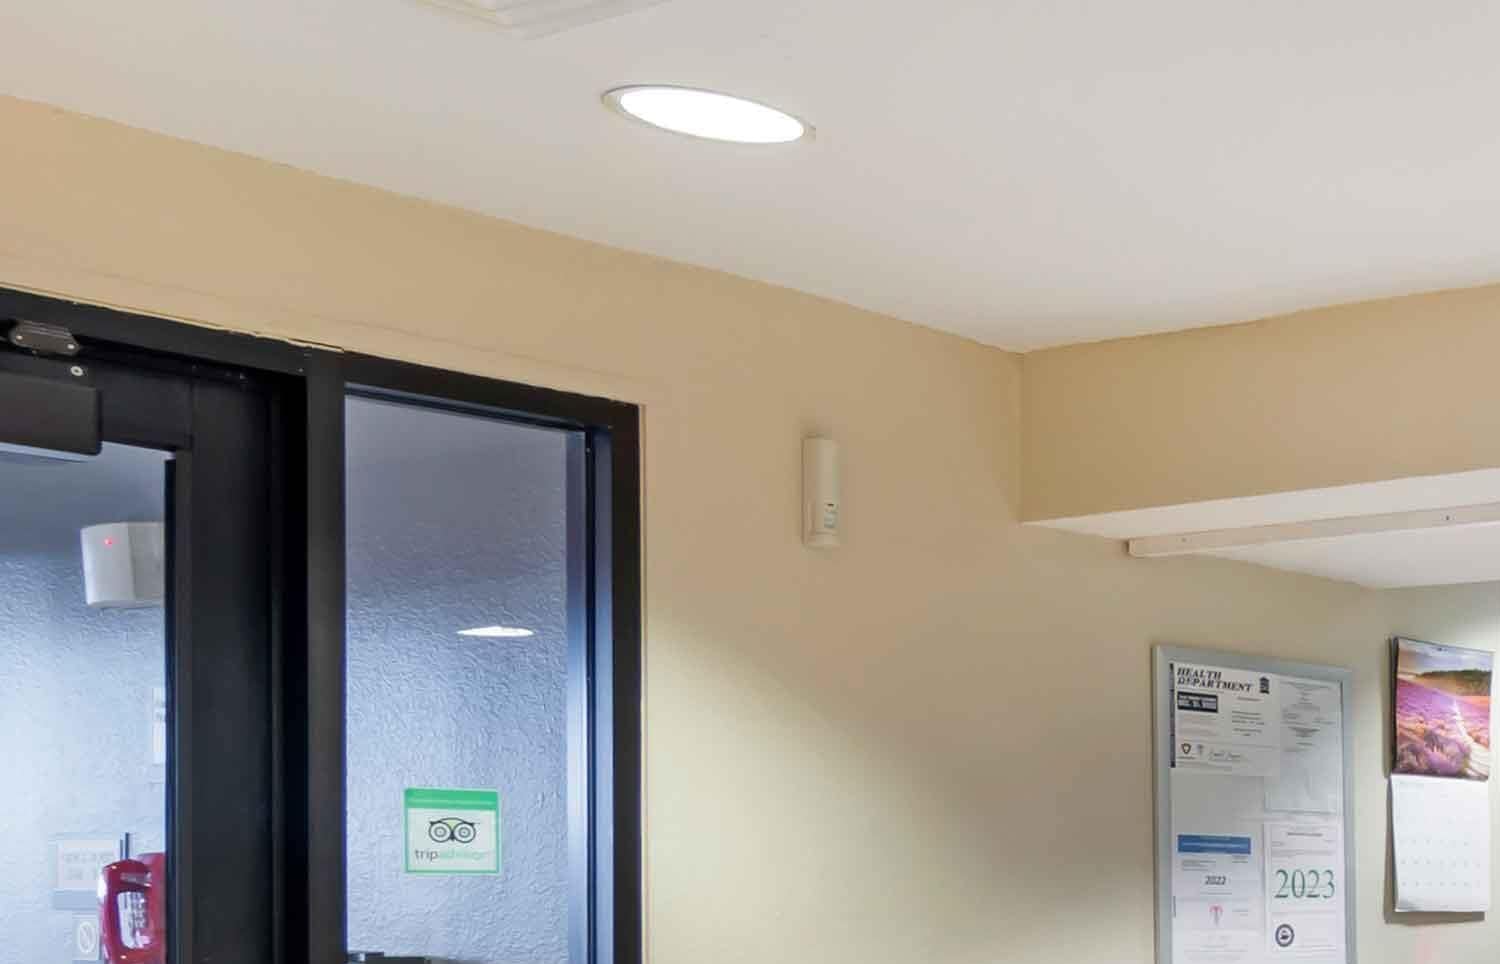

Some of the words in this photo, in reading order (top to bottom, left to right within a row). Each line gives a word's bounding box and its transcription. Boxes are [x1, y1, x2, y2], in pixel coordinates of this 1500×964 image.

[1177, 667, 1222, 680] HEALTH
[414, 848, 489, 861] tripdor
[1274, 868, 1336, 899] 2023
